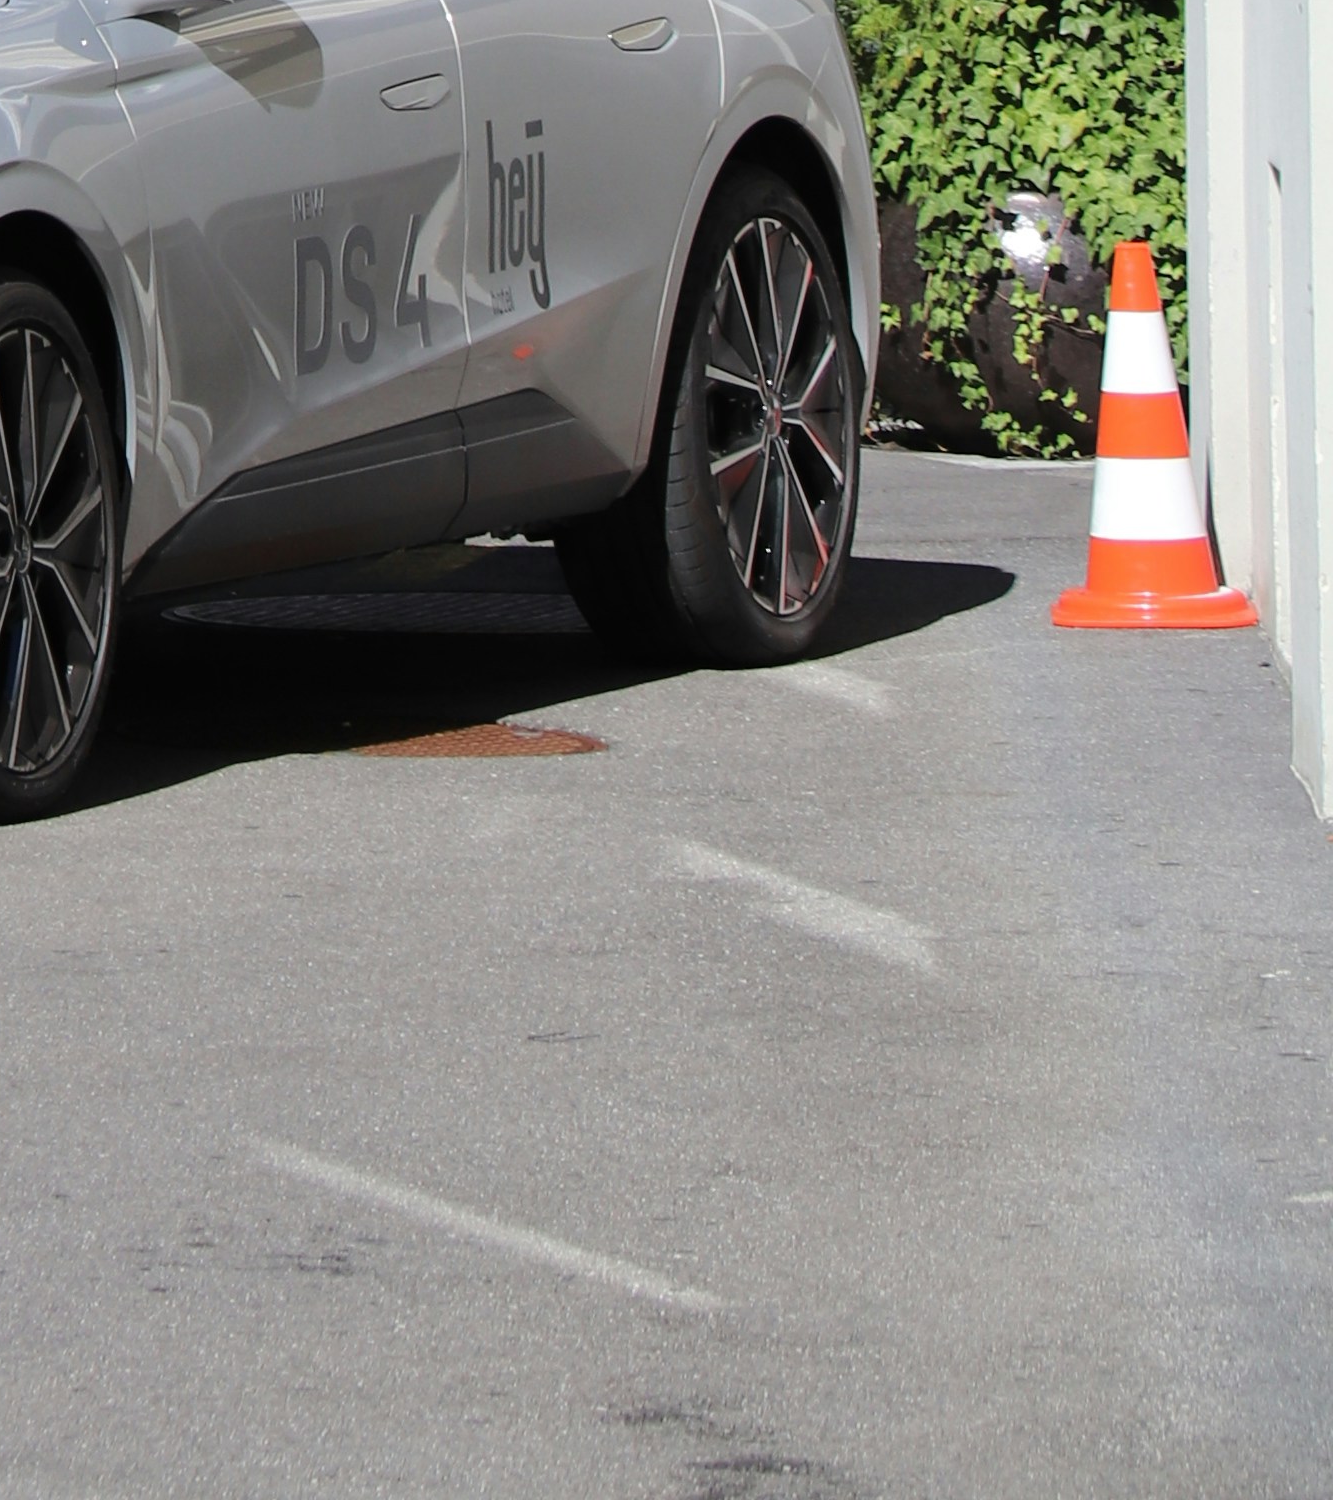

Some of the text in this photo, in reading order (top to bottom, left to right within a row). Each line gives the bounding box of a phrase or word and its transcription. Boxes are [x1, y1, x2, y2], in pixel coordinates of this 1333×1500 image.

[290, 187, 325, 223] NEW
[293, 213, 432, 377] DS 4
